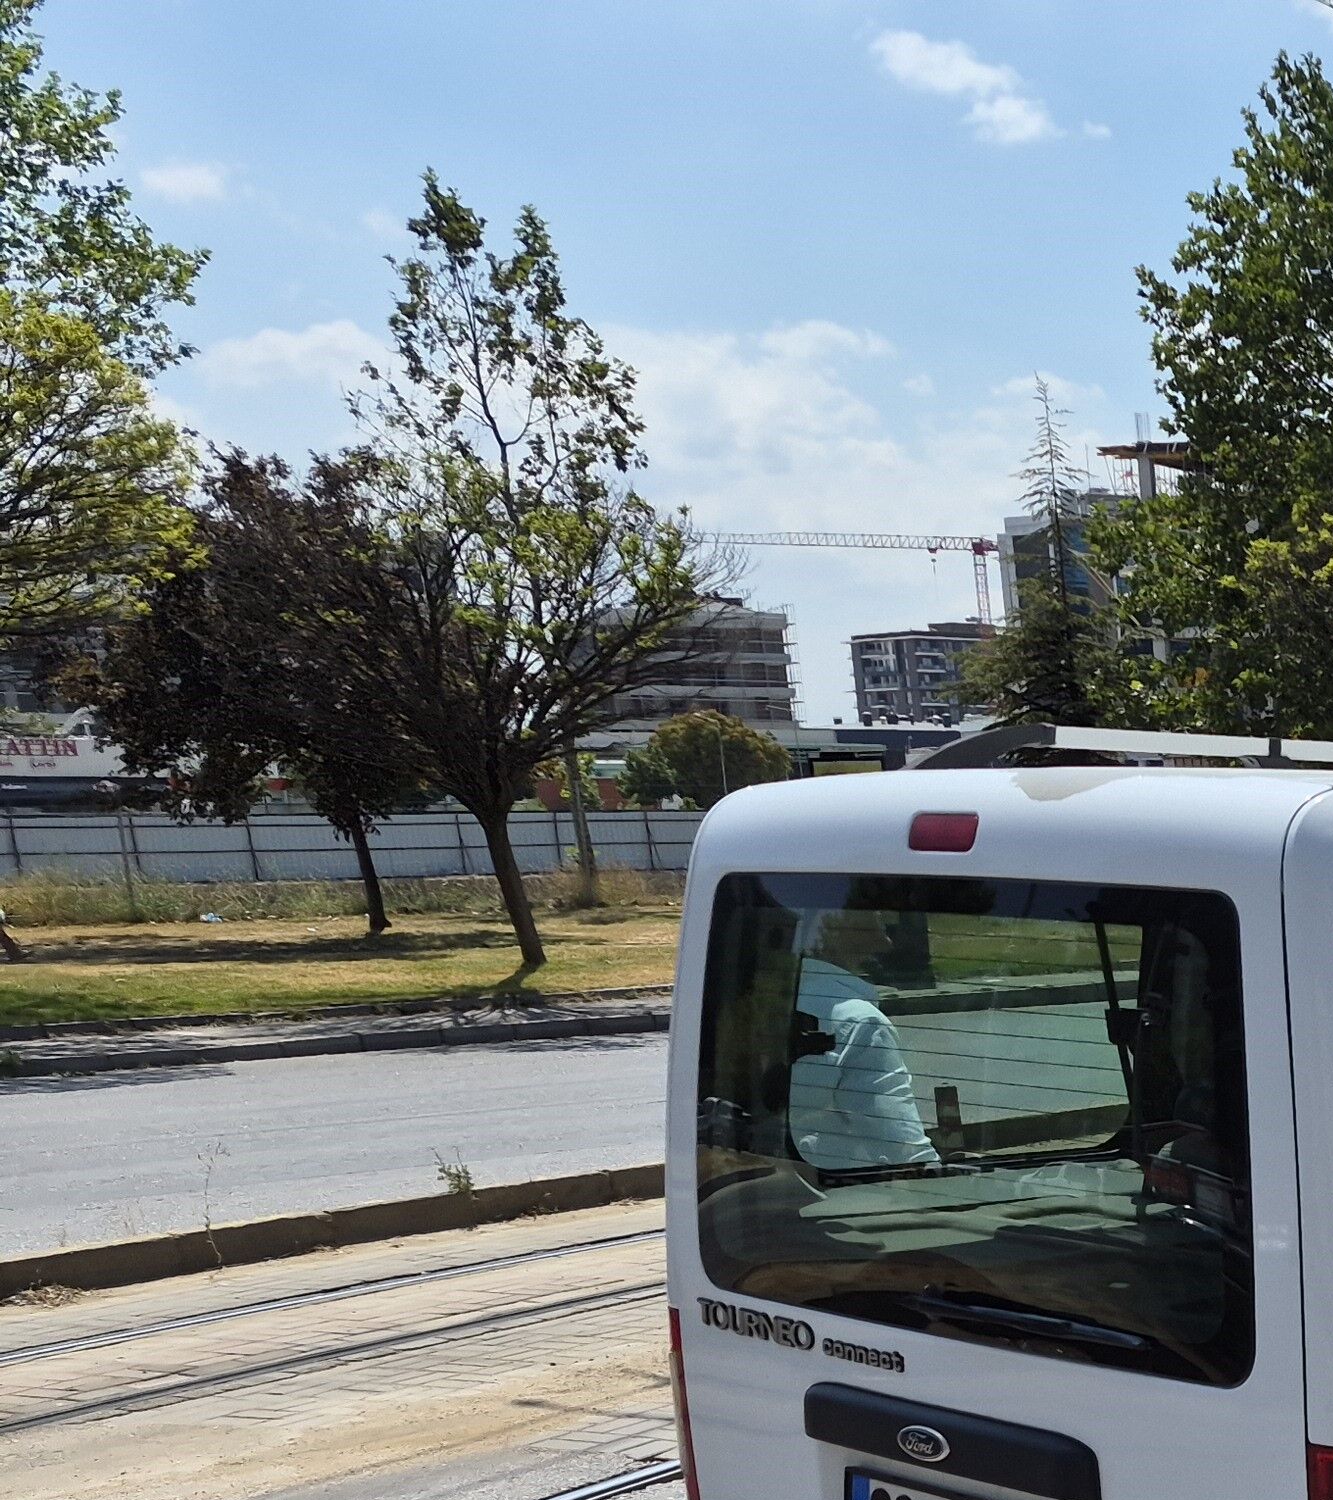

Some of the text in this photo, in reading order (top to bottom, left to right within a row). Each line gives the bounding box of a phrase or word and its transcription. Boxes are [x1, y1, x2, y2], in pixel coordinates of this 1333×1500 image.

[697, 1297, 905, 1373] TOURNEO connect
[904, 1431, 934, 1455] Ford
